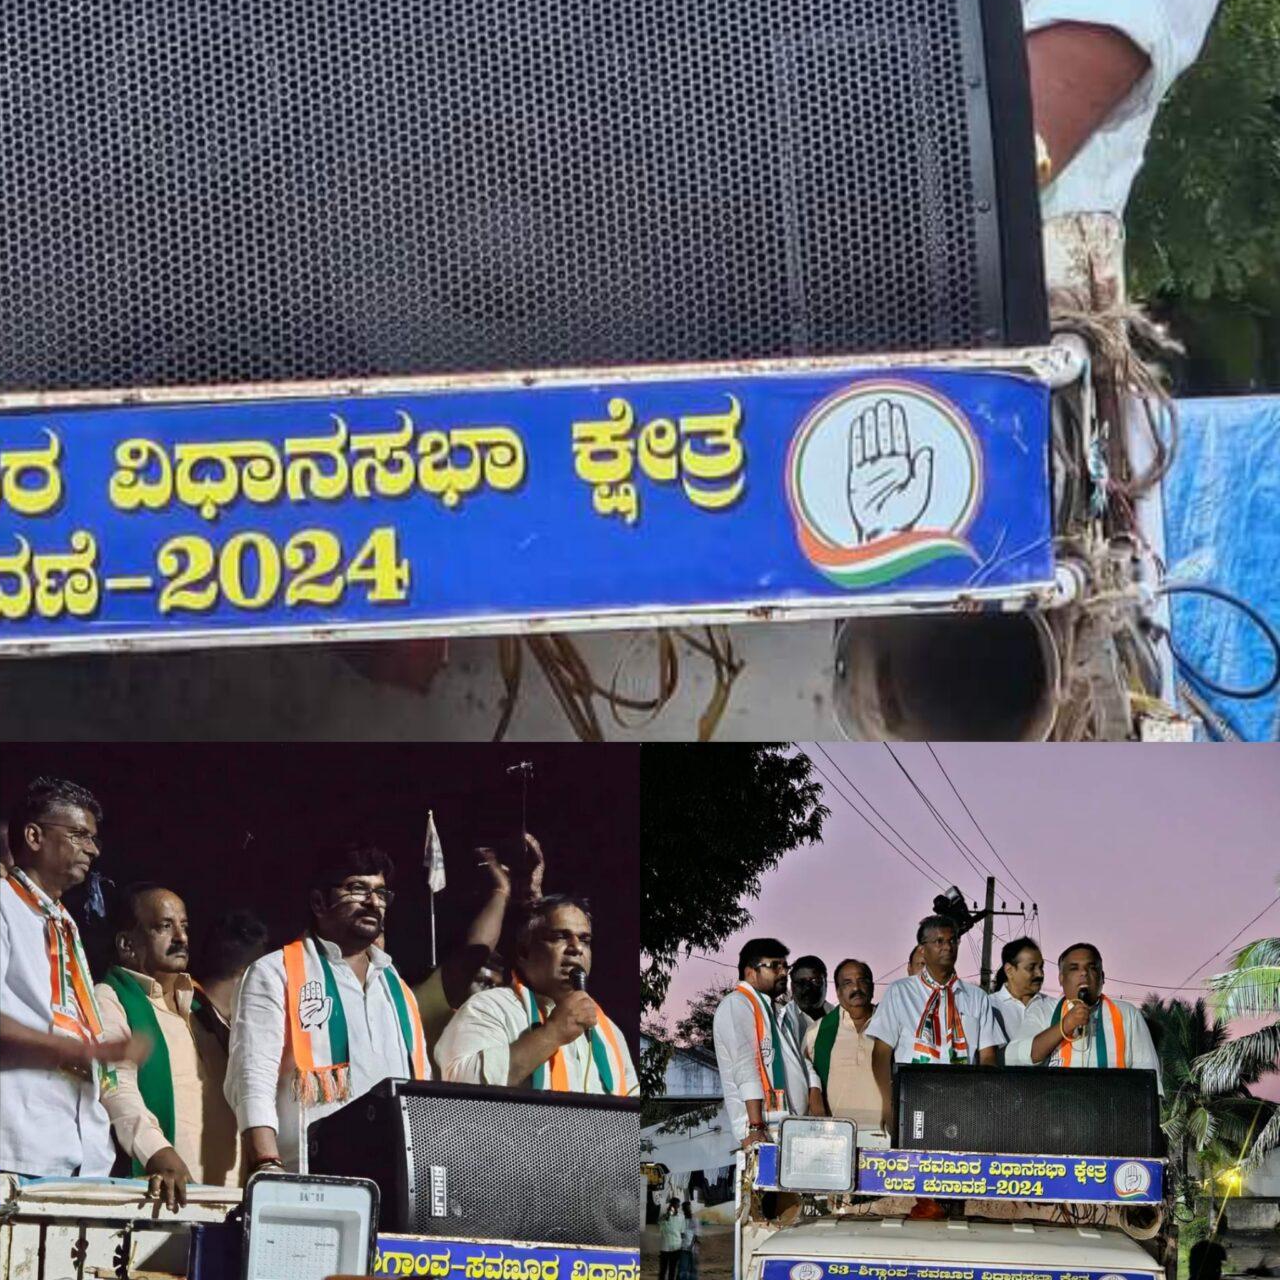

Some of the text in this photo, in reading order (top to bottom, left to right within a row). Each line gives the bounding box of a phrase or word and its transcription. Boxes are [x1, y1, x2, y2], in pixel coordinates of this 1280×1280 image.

[109, 417, 525, 520] ವಿಧಾನಸಭಾ
[572, 392, 746, 524] ಕ್ಷೇತ್ರ
[884, 1175, 916, 1191] ಉಪ
[989, 1160, 1066, 1177] ವಿಧಾನಸಭಾ
[1074, 1160, 1107, 1184] ಕ್ಷೇತ್ರ
[432, 1166, 446, 1216] AHUJA
